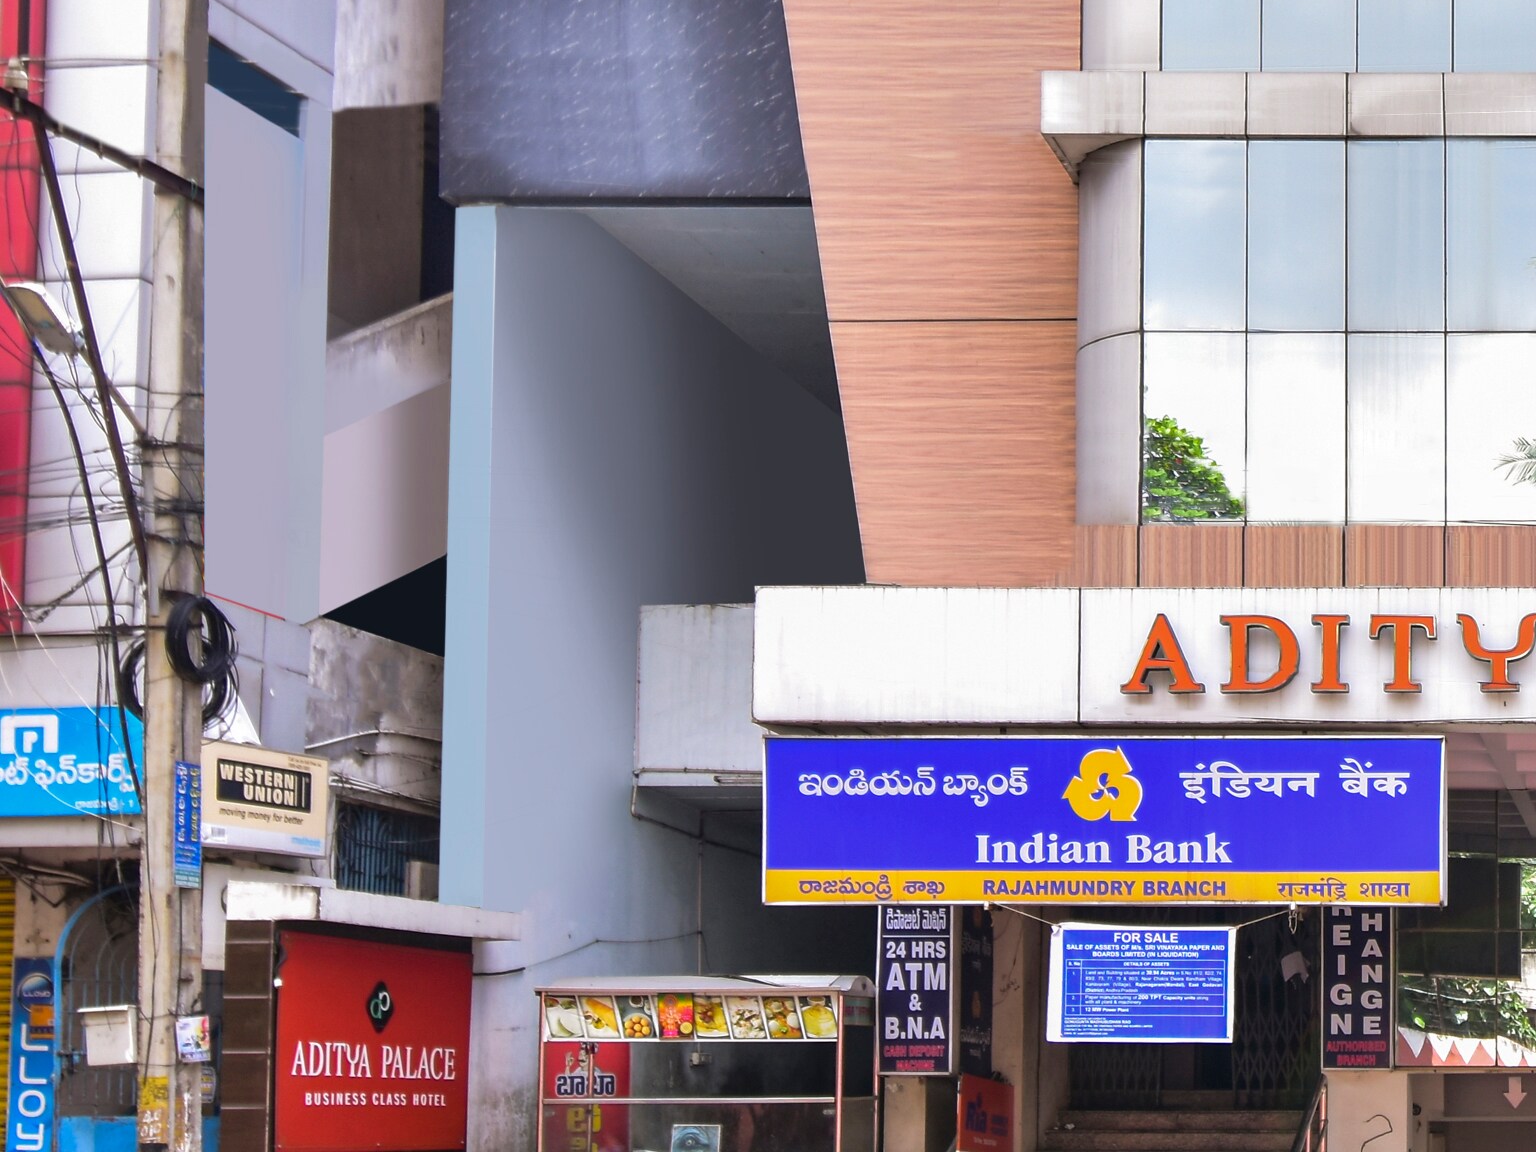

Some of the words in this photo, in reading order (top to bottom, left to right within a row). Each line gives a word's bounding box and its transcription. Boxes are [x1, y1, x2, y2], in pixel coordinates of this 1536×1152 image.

[219, 763, 294, 790] WESTERN
[1179, 760, 1320, 804] इंडियन
[1339, 757, 1410, 798] बैंक
[243, 783, 294, 806] UNION
[798, 766, 937, 797] ఇండియన్
[942, 766, 1030, 807] బ్యాంక్
[219, 808, 247, 820] moving
[247, 811, 271, 823] money
[272, 813, 283, 822] for
[283, 815, 304, 825] better
[975, 832, 1112, 864] Indian
[1126, 832, 1232, 864] Bank
[798, 874, 894, 900] రాజమండ్రి
[902, 878, 946, 900] శాఖ
[983, 879, 1136, 896] RAJAHMUNDRY
[1143, 880, 1227, 896] BRANCH
[1359, 881, 1411, 898] शाखा
[1114, 932, 1141, 943] FOR
[1144, 932, 1179, 943] SALE
[886, 942, 907, 959] 24
[911, 941, 946, 959] HRS
[885, 962, 946, 991] ATM
[908, 993, 922, 1012] &
[884, 1016, 945, 1040] B.N.A
[291, 1040, 372, 1078] ADITYA
[381, 1044, 456, 1080] PALACE
[883, 1045, 907, 1058] CASH
[908, 1045, 945, 1058] DEPOSIT
[1336, 1054, 1376, 1066] BRANCH
[895, 1059, 935, 1072] MACHINE
[304, 1092, 367, 1107] BUSINESS
[372, 1093, 407, 1107] CLASS
[412, 1094, 447, 1107] HOTEL
